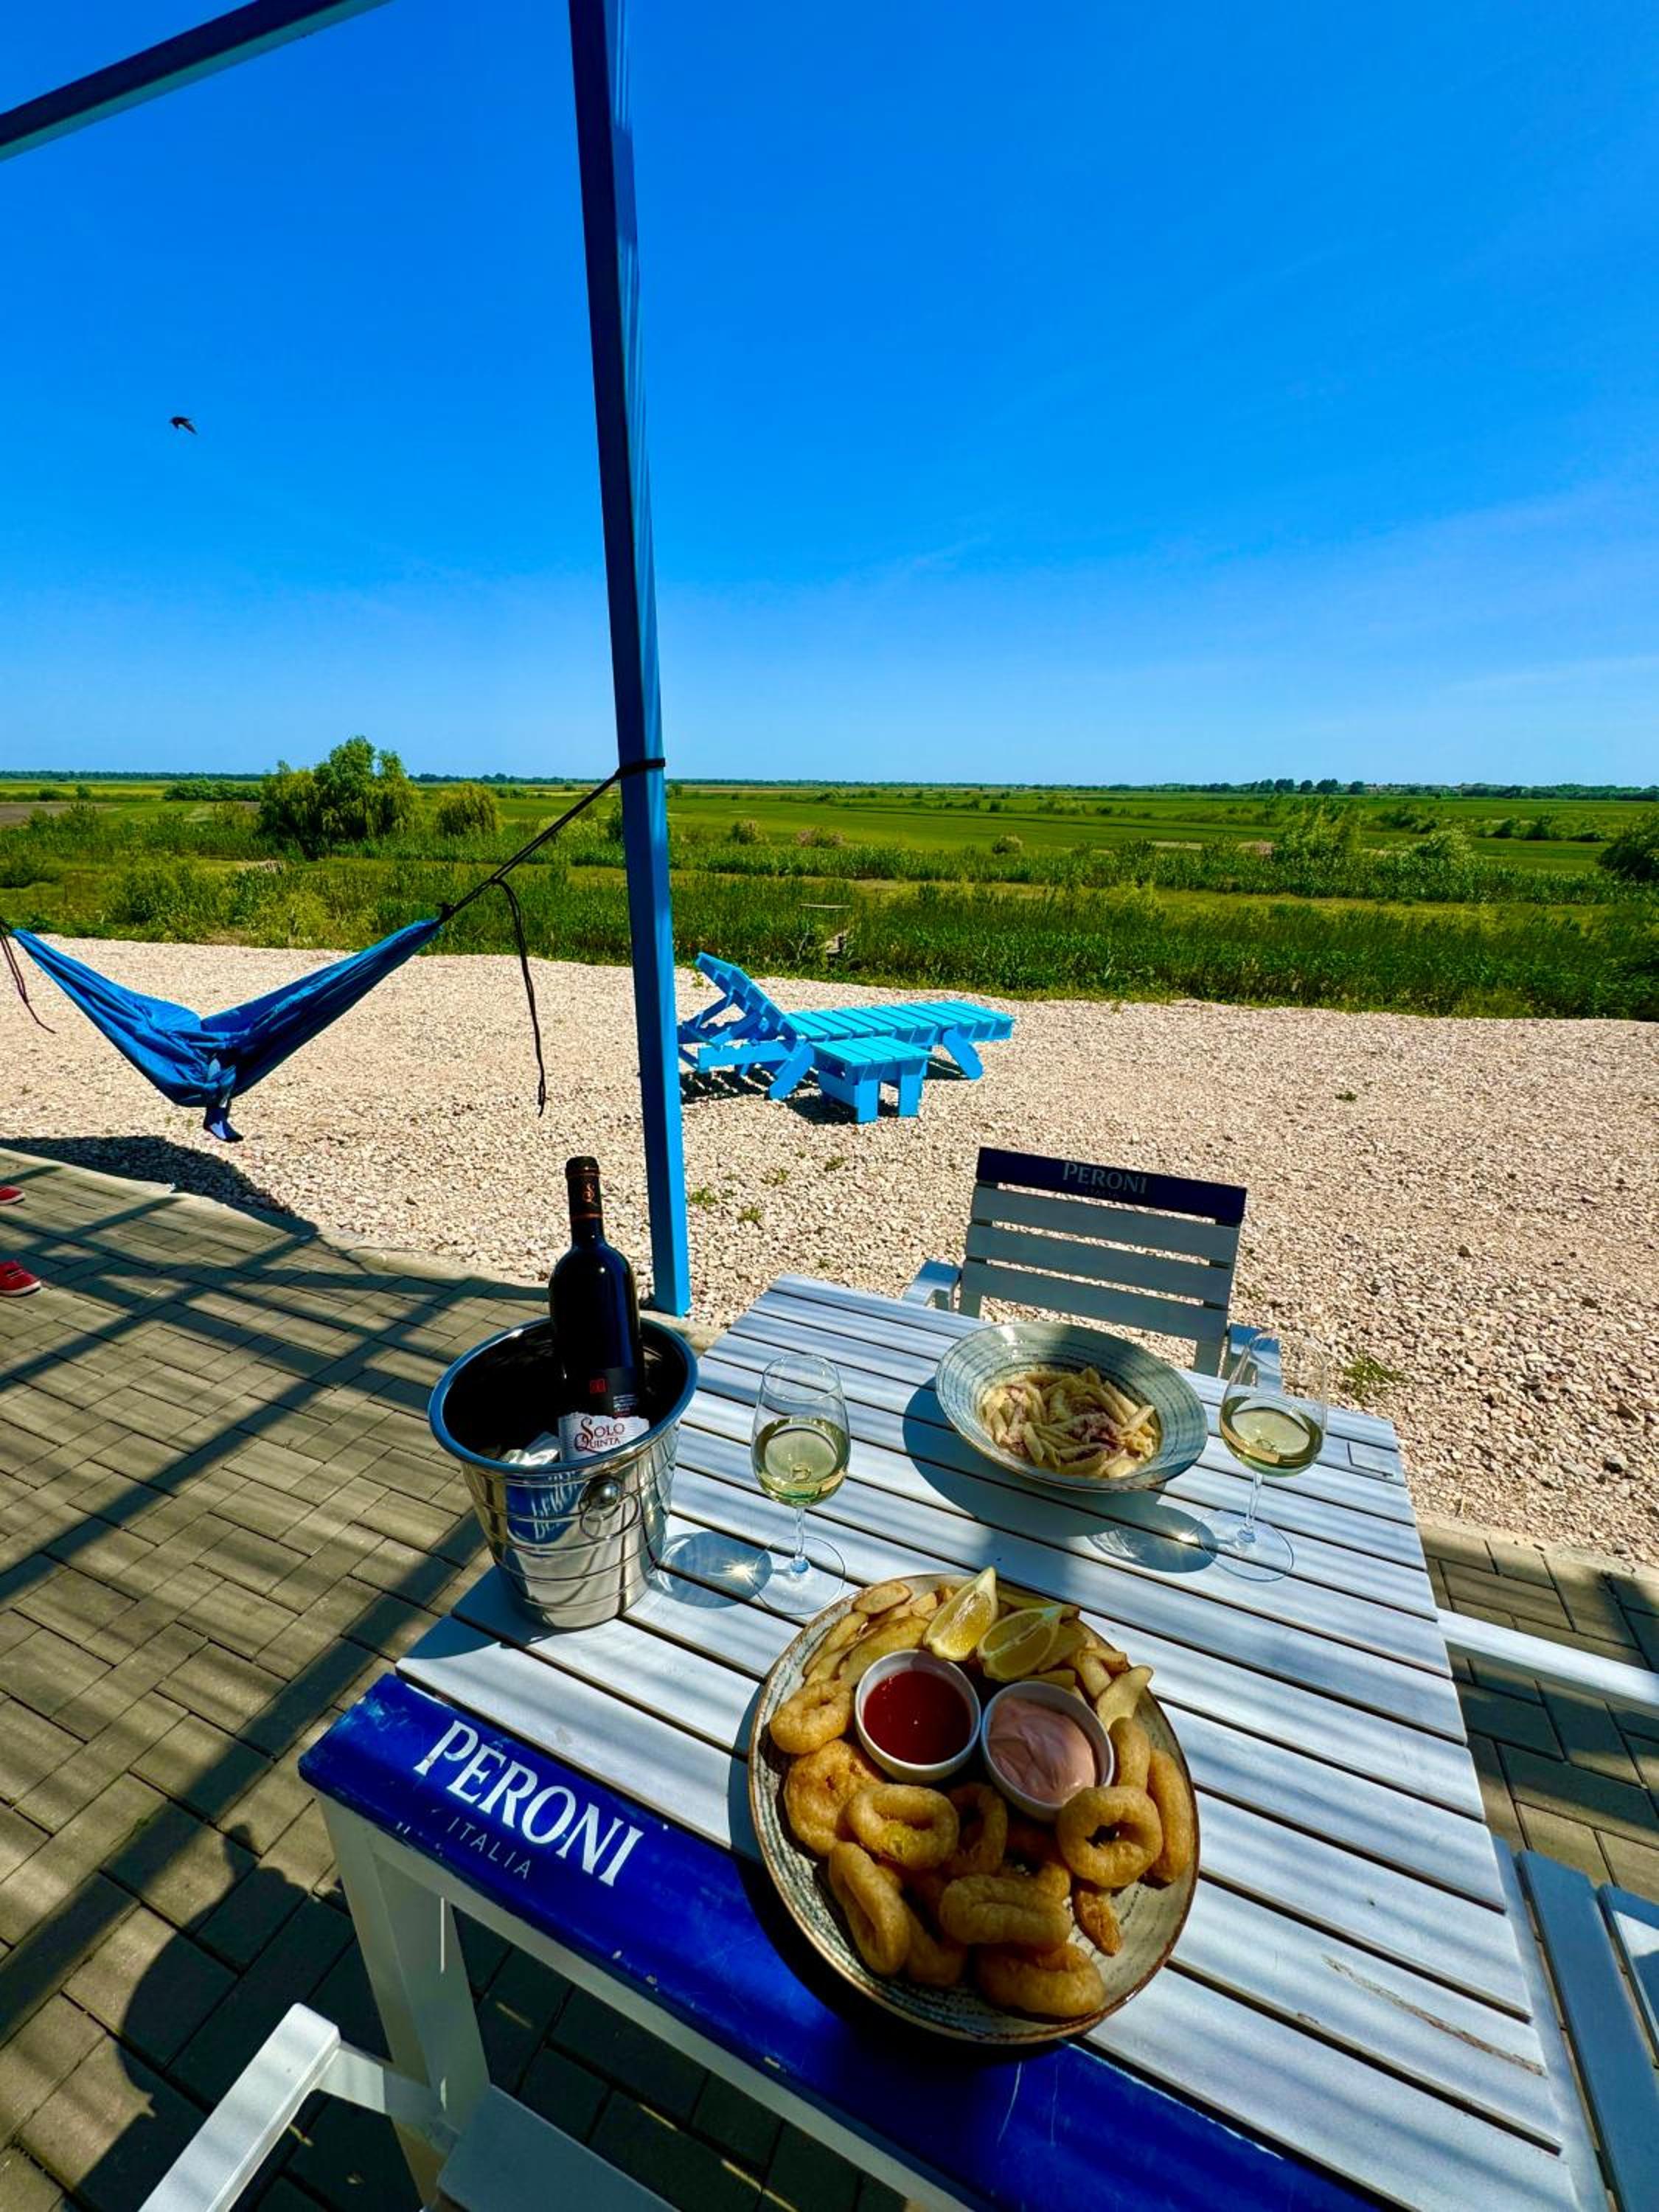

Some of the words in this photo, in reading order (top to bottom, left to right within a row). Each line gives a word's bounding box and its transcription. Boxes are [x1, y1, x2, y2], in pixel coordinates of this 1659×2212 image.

[1062, 1162, 1147, 1194] PERONI
[413, 1720, 644, 1887] PERONI
[447, 1817, 532, 1879] ITALIA
